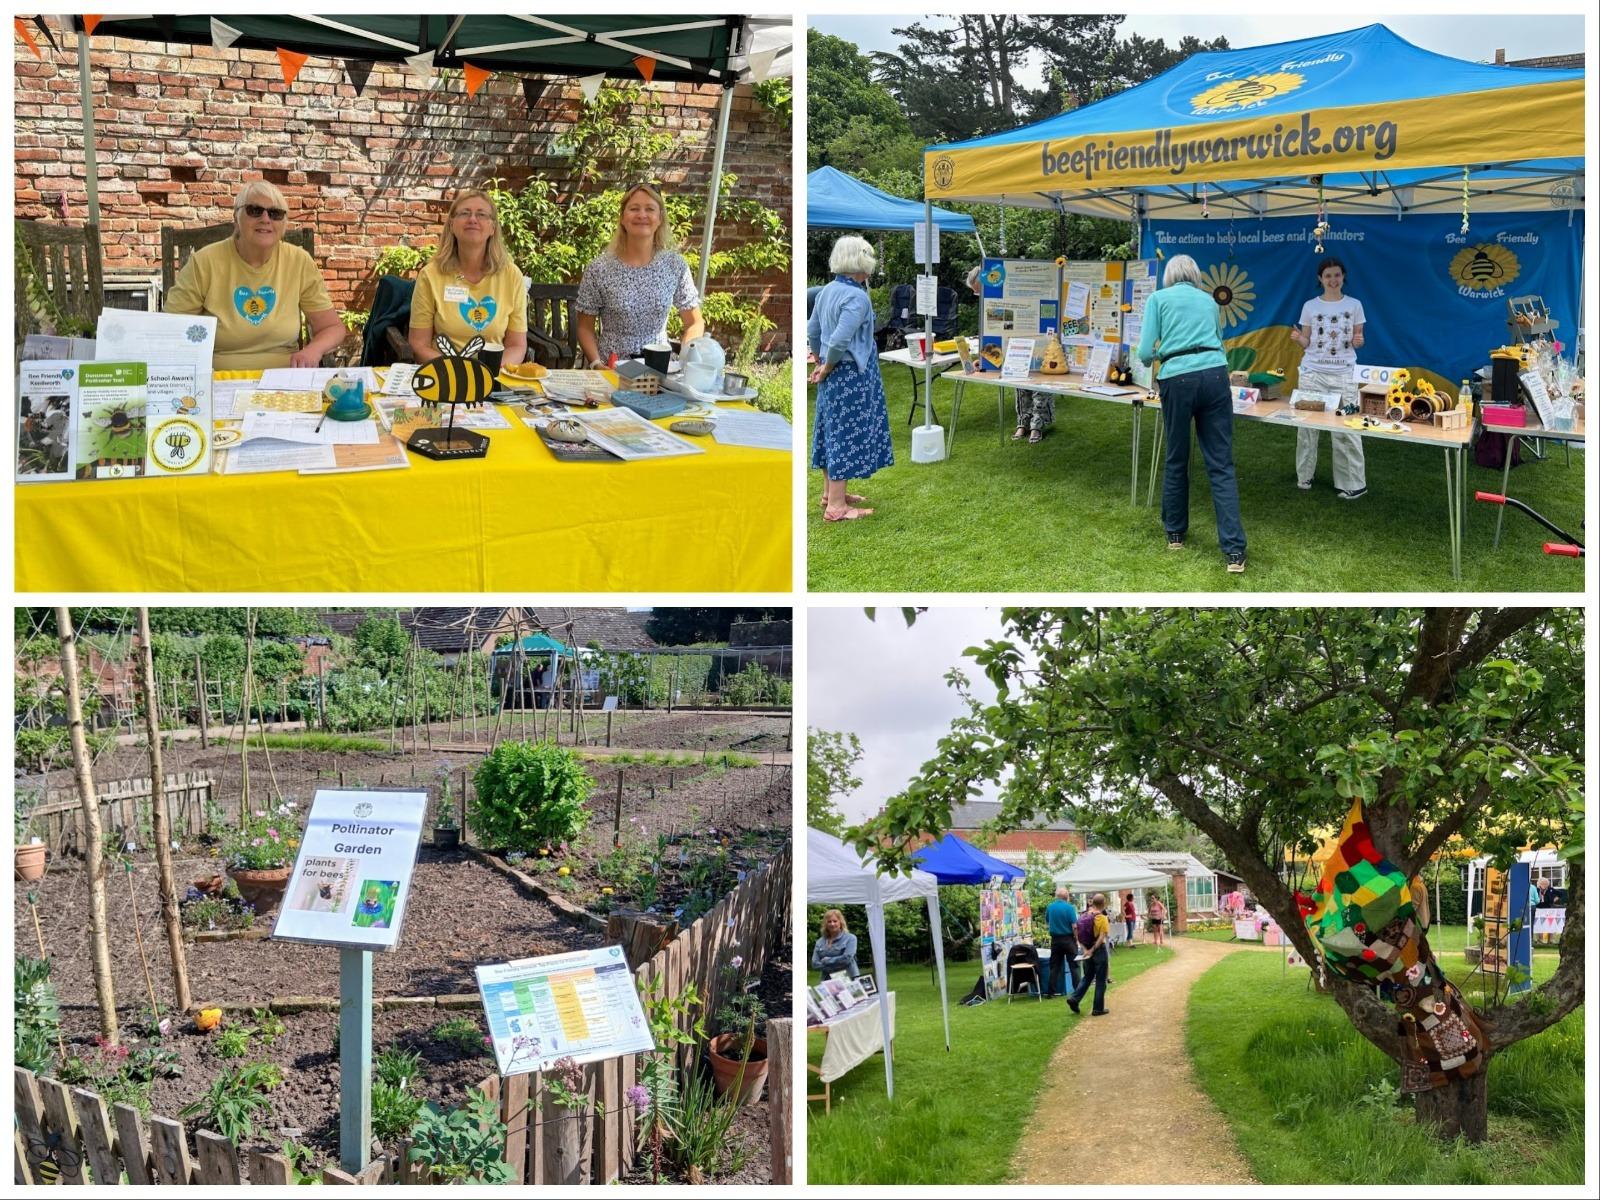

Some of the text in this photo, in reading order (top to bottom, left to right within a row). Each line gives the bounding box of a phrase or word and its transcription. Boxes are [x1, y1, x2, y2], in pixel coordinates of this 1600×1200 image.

[1279, 53, 1345, 71] Friendly
[1190, 100, 1269, 115] Warwick
[1041, 112, 1398, 179] beefriendlywarwick.org
[1155, 230, 1177, 244] Take
[1178, 231, 1204, 244] action
[1206, 231, 1215, 244] to
[1217, 231, 1236, 245] help
[1238, 229, 1260, 244] local
[1262, 228, 1285, 243] bees
[1286, 227, 1306, 243] and
[1445, 231, 1539, 245] Bee Friendly
[1458, 284, 1505, 299] Warwick
[331, 823, 395, 836] Pollinator
[334, 843, 382, 855] Garden
[305, 858, 337, 868] plants
[302, 868, 345, 879] for bees
